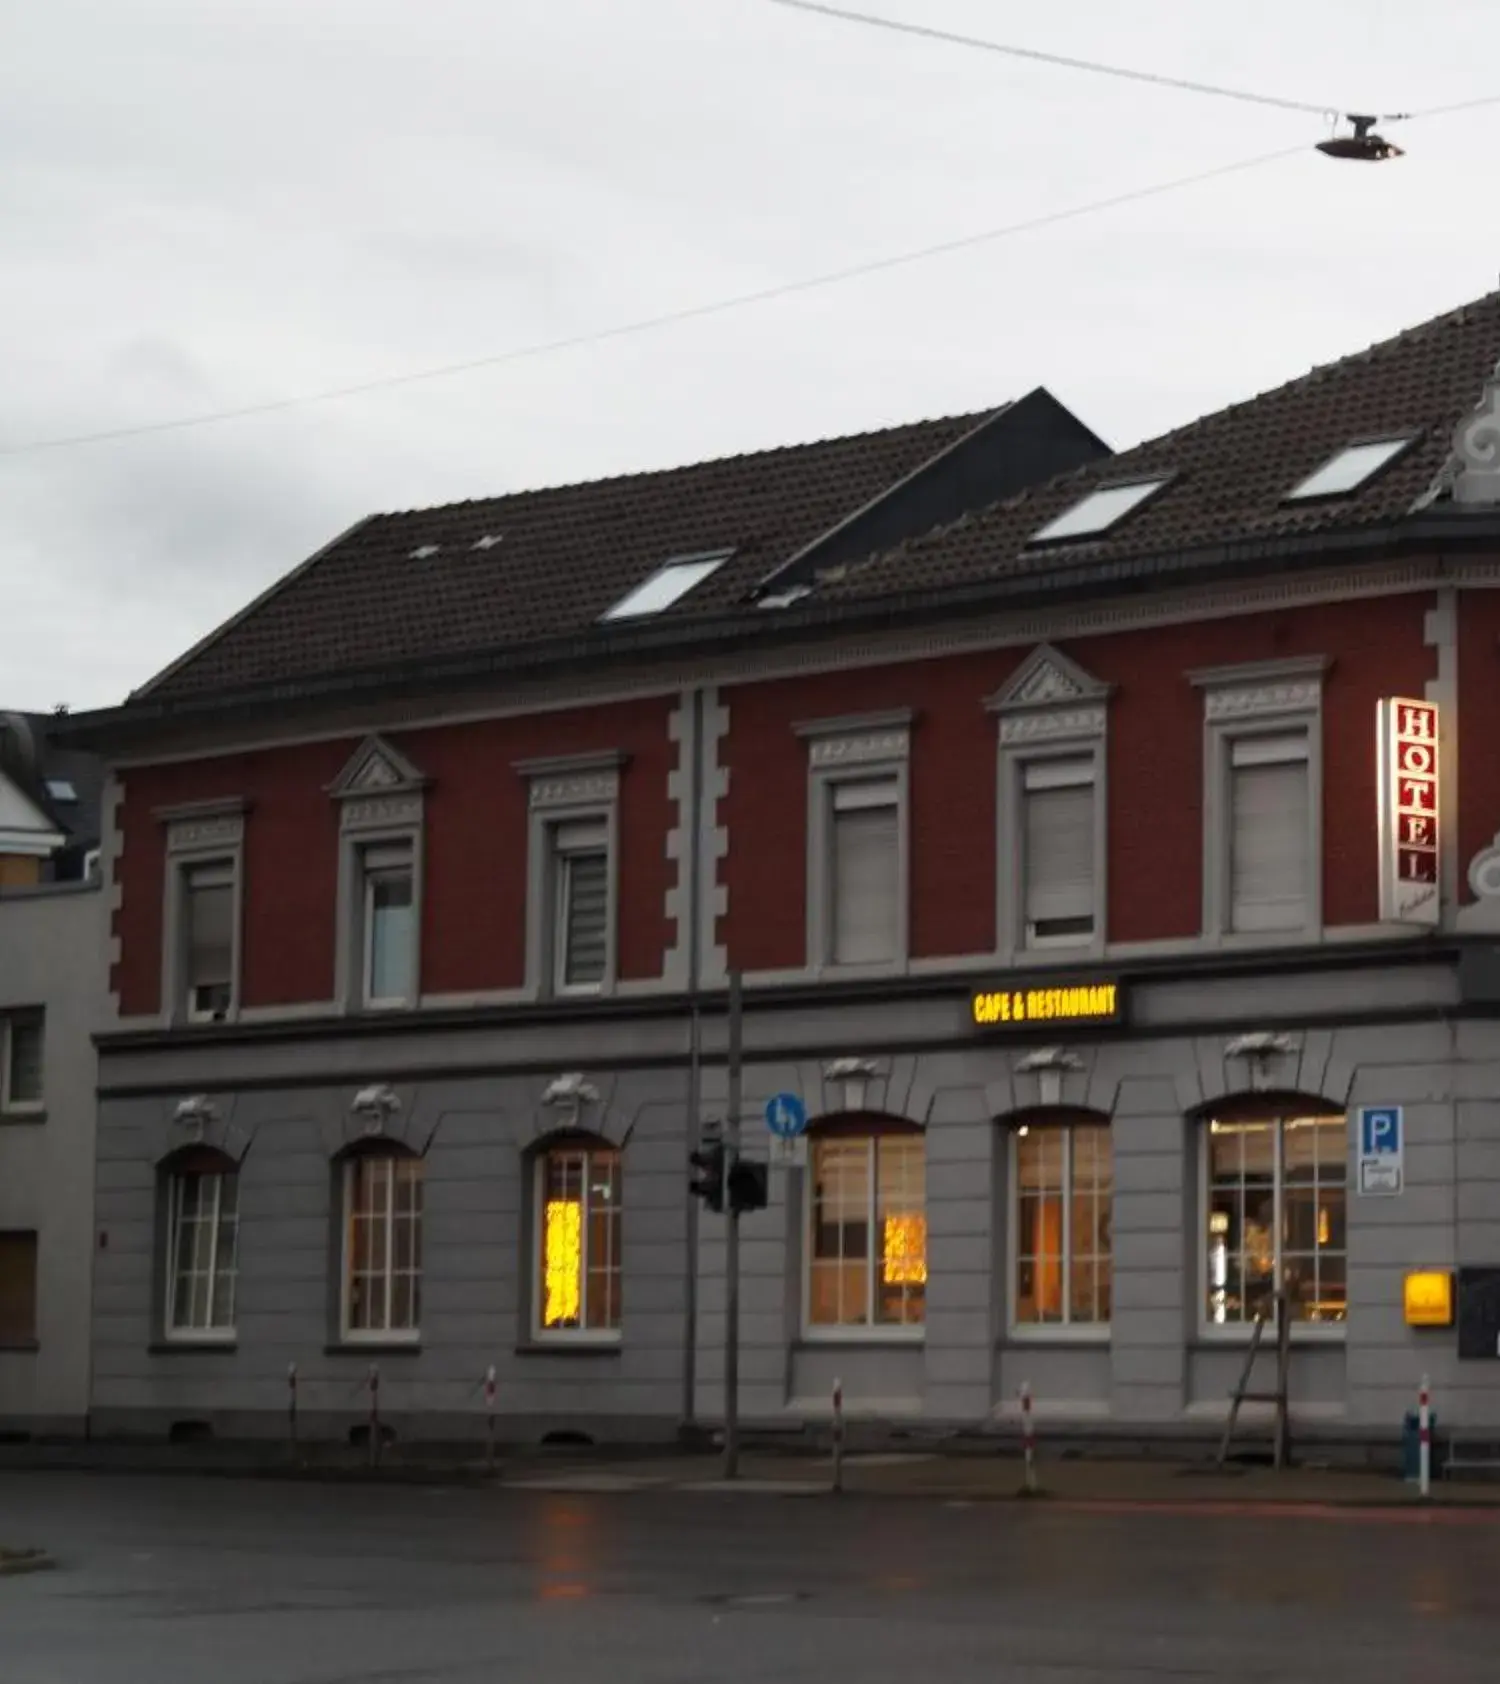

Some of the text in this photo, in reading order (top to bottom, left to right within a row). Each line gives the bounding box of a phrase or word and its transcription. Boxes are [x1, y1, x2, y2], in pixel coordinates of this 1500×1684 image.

[1402, 708, 1430, 880] HOTEL
[974, 984, 1116, 1023] CAFE & RESTAURANT
[1371, 1113, 1391, 1147] P
